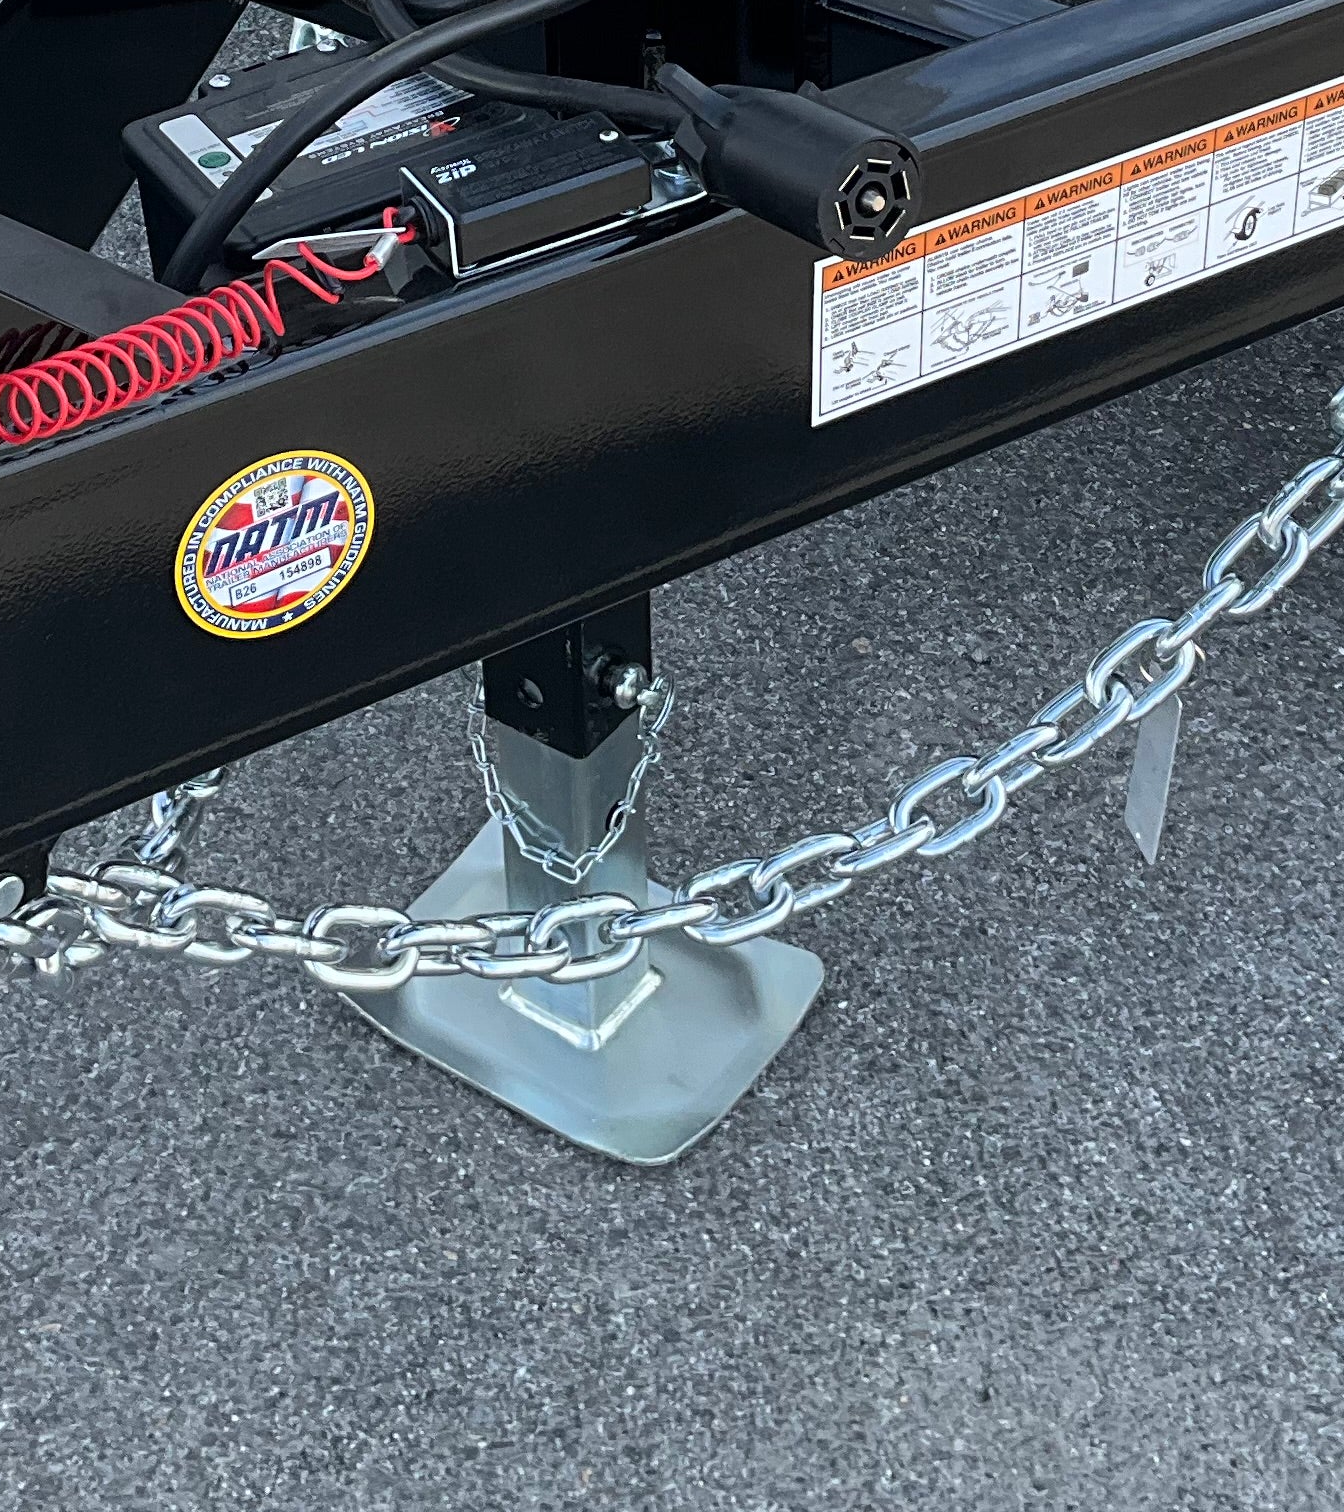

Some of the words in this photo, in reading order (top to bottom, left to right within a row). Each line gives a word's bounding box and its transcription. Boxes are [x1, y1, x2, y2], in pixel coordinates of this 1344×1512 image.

[1235, 105, 1298, 137] WARNING
[1143, 138, 1207, 171] WARNING
[1047, 171, 1112, 205] WARNING
[948, 206, 1015, 240] WARNING
[846, 241, 915, 277] WARNING
[307, 457, 345, 481] WITH
[199, 457, 304, 528] COMPLIANCE
[344, 477, 368, 520] NATM
[187, 531, 202, 550] IN
[206, 557, 264, 586] NATIONAL
[264, 529, 331, 562] ASSOCIATION
[333, 522, 348, 535] OF
[207, 570, 250, 594] TRAILER
[251, 528, 348, 577] MANUFACTURERS
[279, 554, 323, 581] 154898
[304, 521, 367, 610] GUIDELINES
[182, 554, 268, 631] MANUFACTURED
